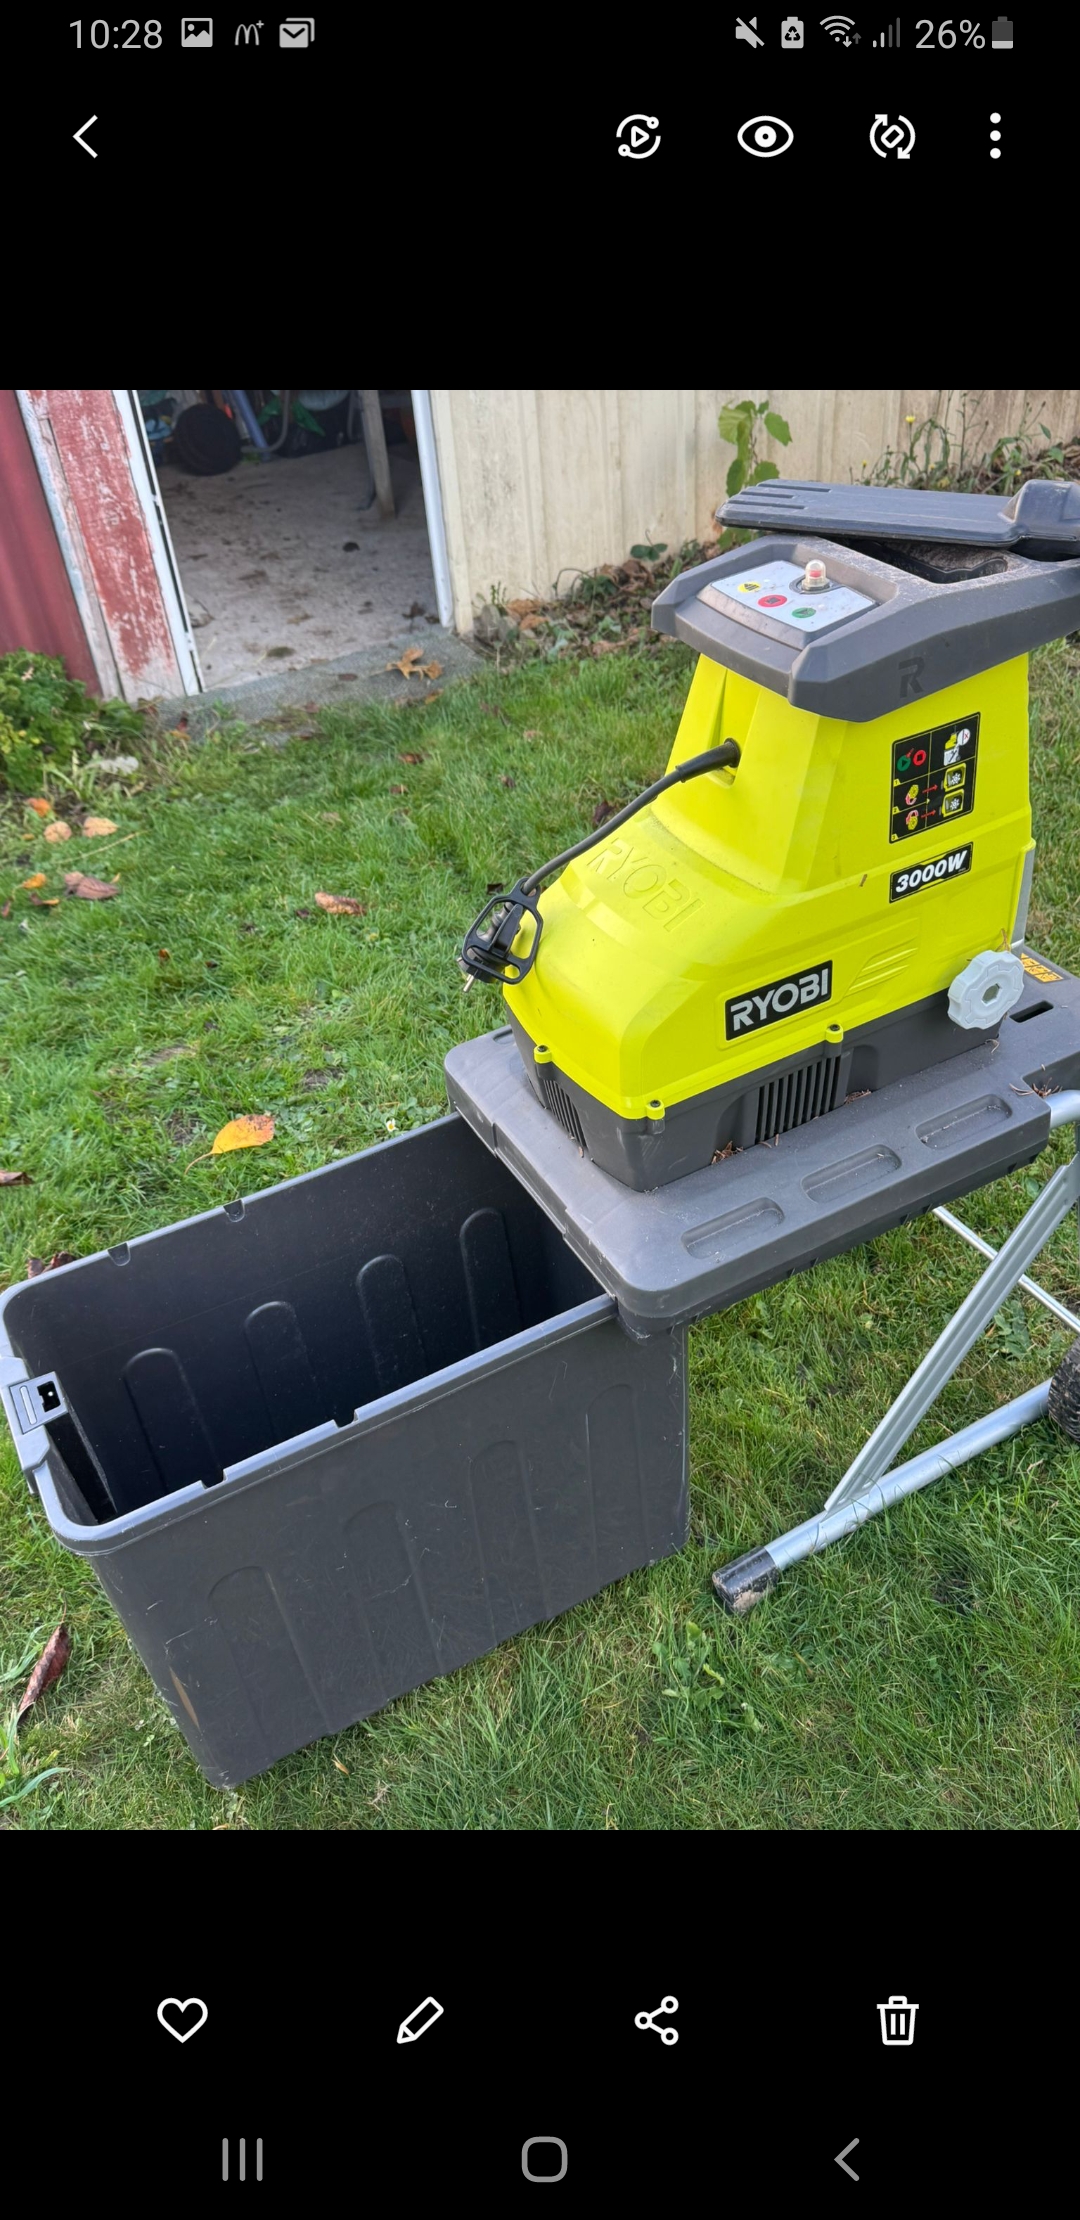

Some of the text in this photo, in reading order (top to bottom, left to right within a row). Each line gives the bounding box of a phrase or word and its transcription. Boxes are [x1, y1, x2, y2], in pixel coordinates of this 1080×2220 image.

[587, 837, 706, 932] RYOBI
[896, 850, 967, 892] 3000W
[730, 968, 829, 1032] RYOBI
